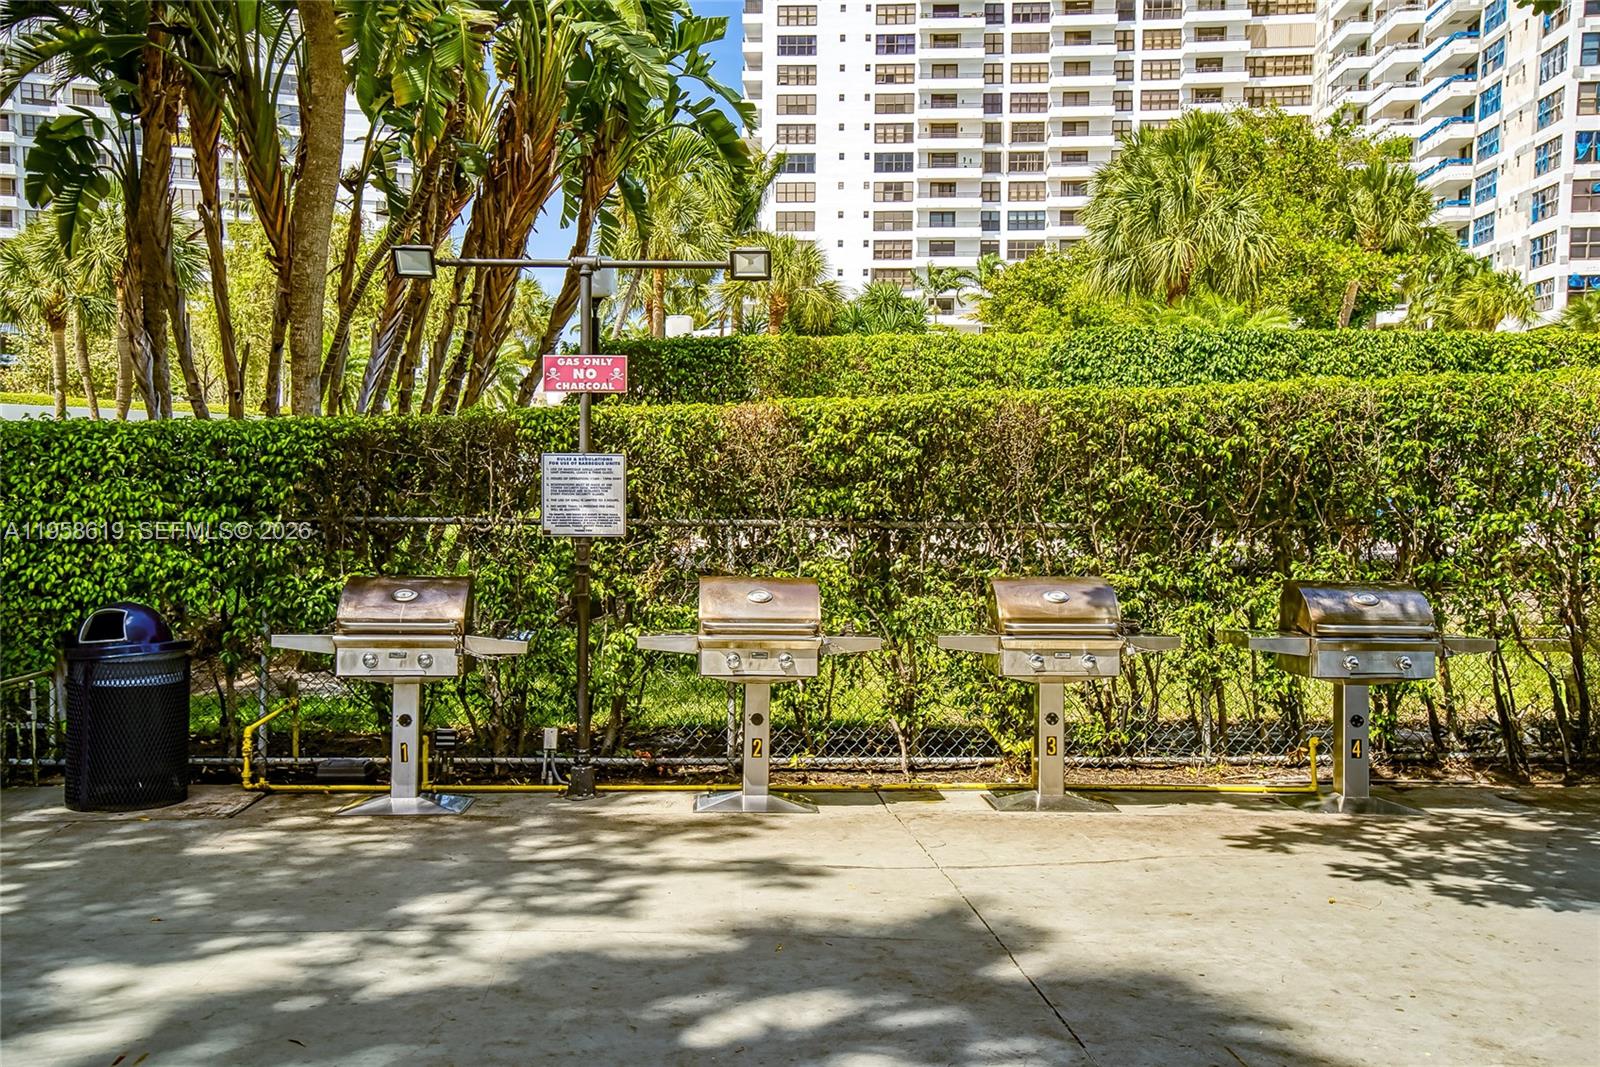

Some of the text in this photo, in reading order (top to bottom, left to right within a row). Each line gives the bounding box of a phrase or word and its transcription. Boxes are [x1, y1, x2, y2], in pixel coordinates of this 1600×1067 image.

[557, 358, 613, 366] GAS ONLY
[573, 368, 597, 379] NO
[555, 382, 615, 390] CHARCOAL
[402, 744, 408, 762] 1
[753, 739, 761, 757] 2
[1048, 737, 1056, 755] 3
[1352, 740, 1361, 758] 4
